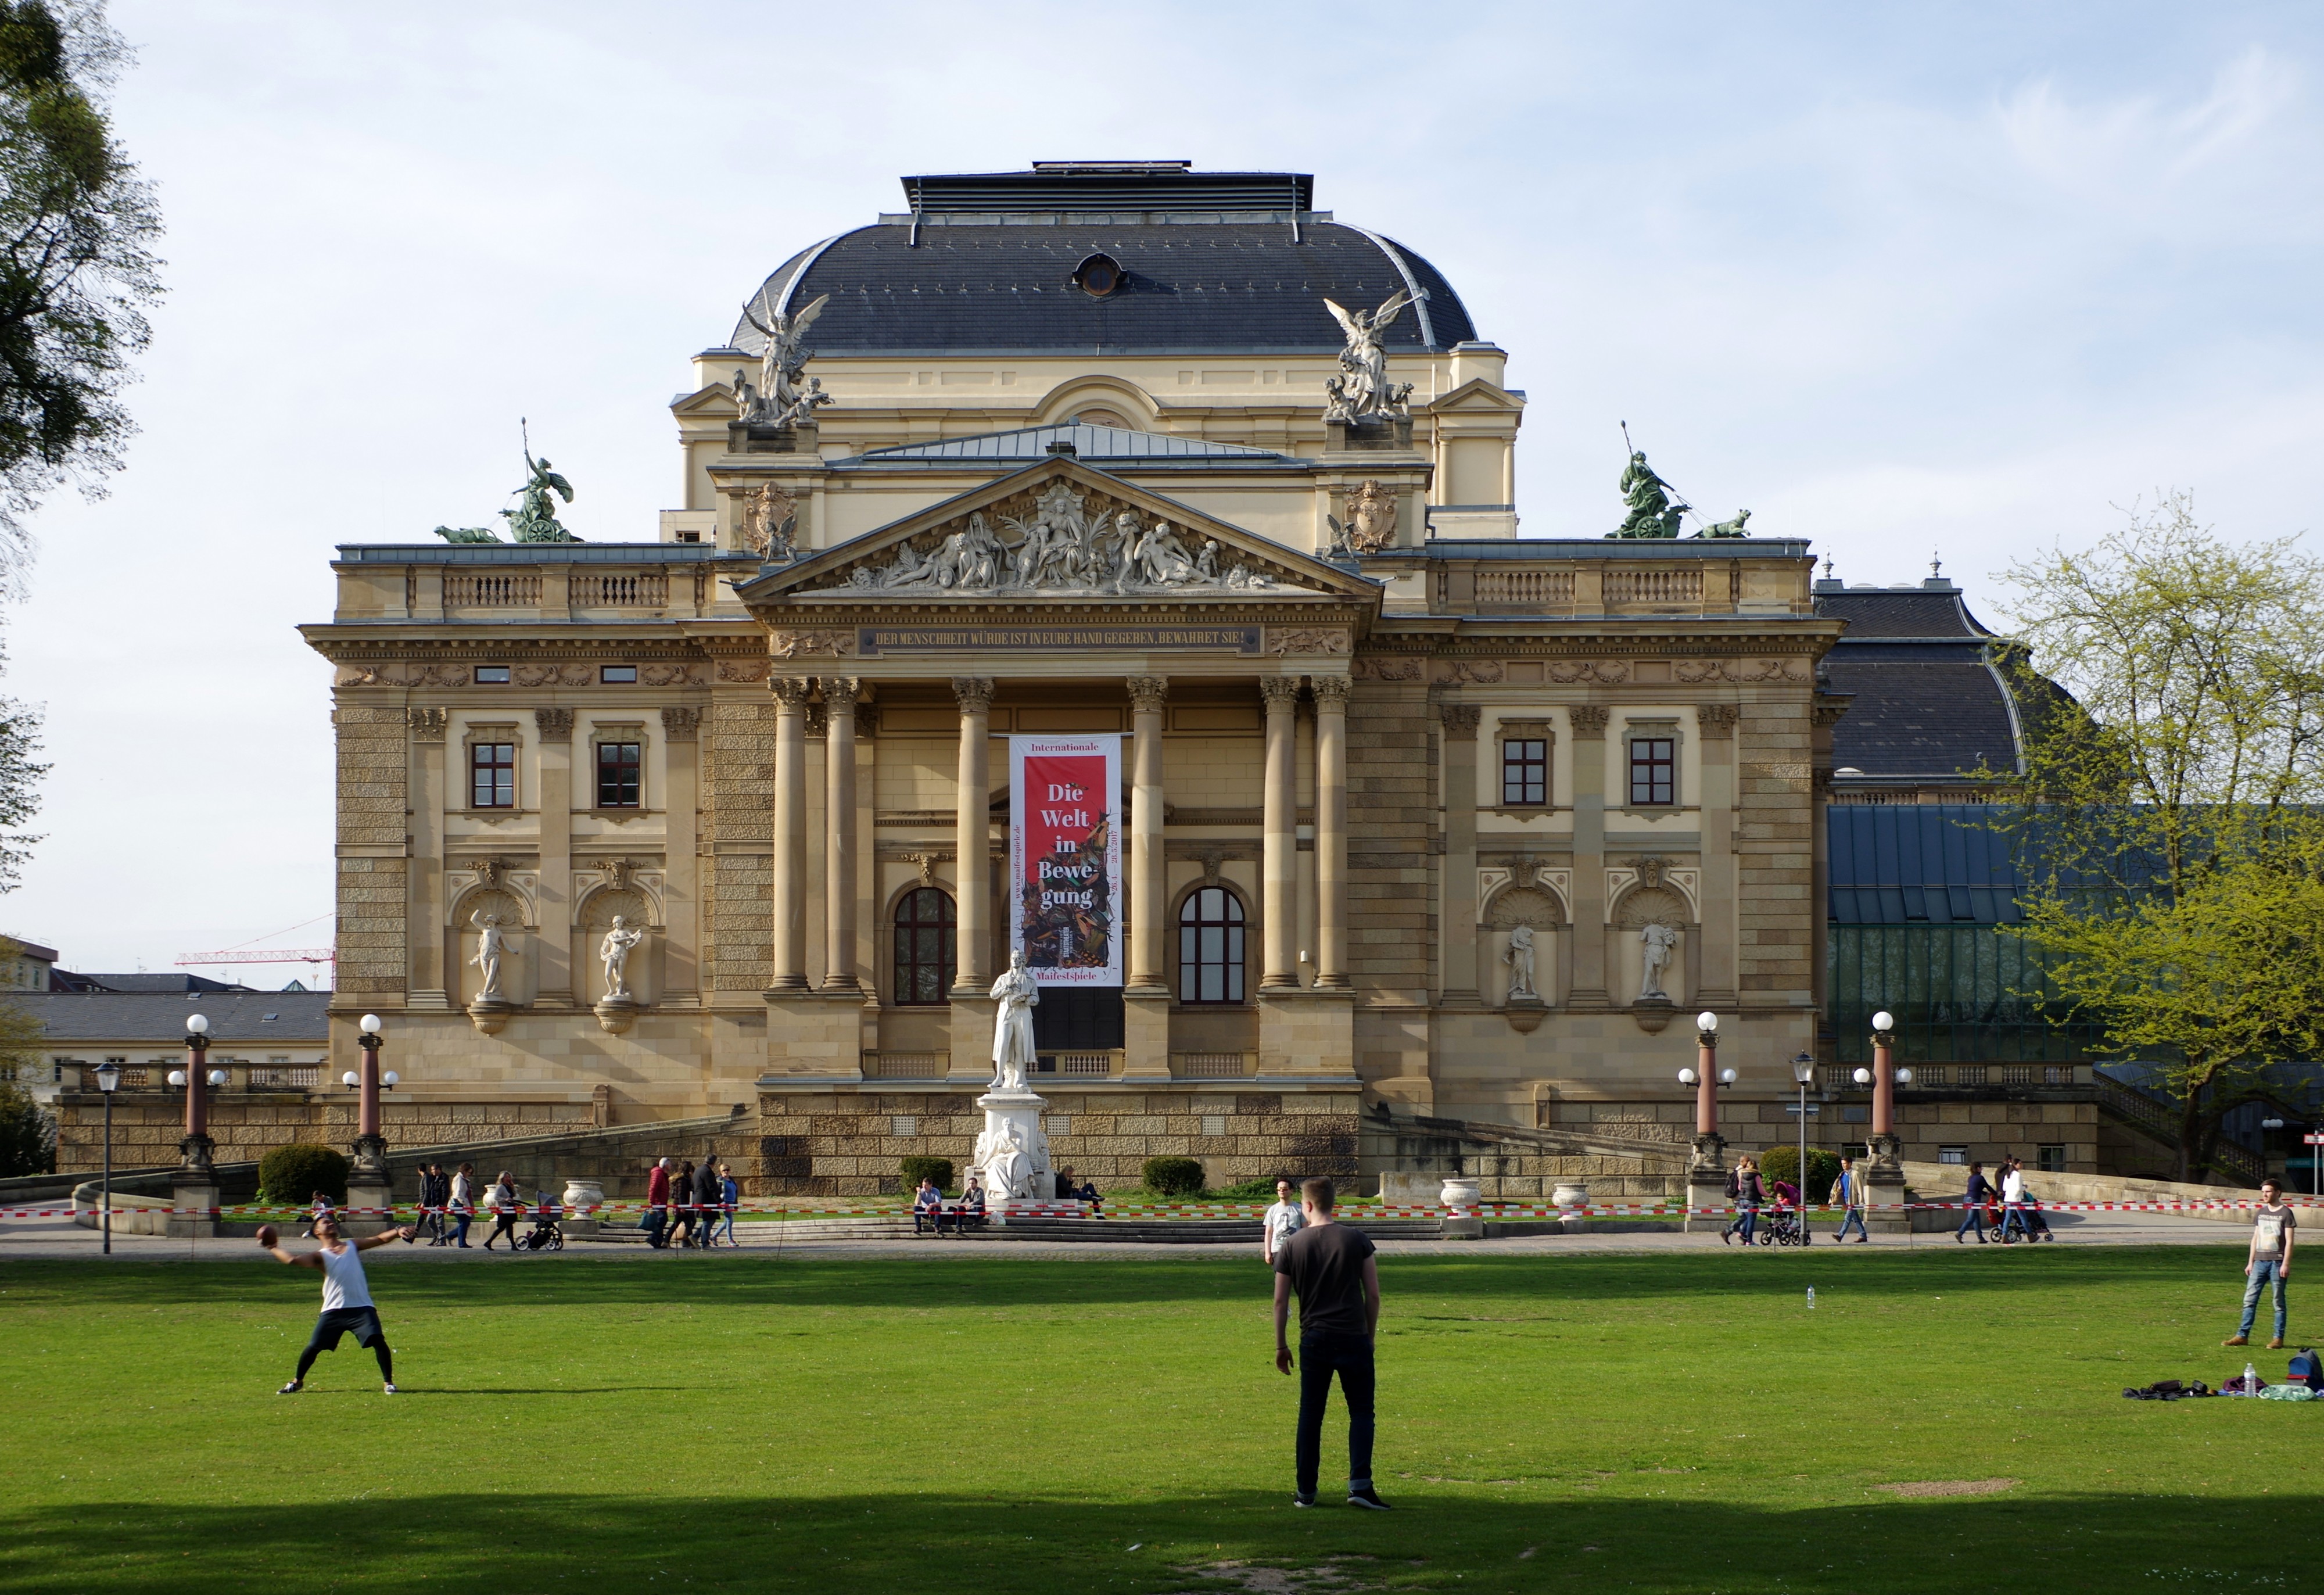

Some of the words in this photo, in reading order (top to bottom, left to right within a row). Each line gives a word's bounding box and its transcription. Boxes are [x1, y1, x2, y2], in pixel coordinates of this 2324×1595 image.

[876, 632, 898, 645] DER
[900, 632, 968, 644] MENSCHHEIT
[971, 630, 1009, 644] WÜRDE
[1010, 632, 1028, 644] IST
[1030, 632, 1041, 644] IN
[1043, 632, 1071, 644] EURE
[1074, 632, 1102, 644] HAND
[1159, 632, 1219, 644] BEWAHRET
[1222, 632, 1245, 644] SIE!
[1031, 743, 1099, 752] Internationale
[1048, 783, 1084, 802] Die
[1041, 809, 1089, 827] Welt
[1055, 836, 1076, 853] in
[1013, 825, 1022, 899] www.maifestspiele.de
[1038, 861, 1099, 879] Bewe-
[1041, 889, 1093, 911] gung
[1036, 972, 1097, 982] Maifestspiele
